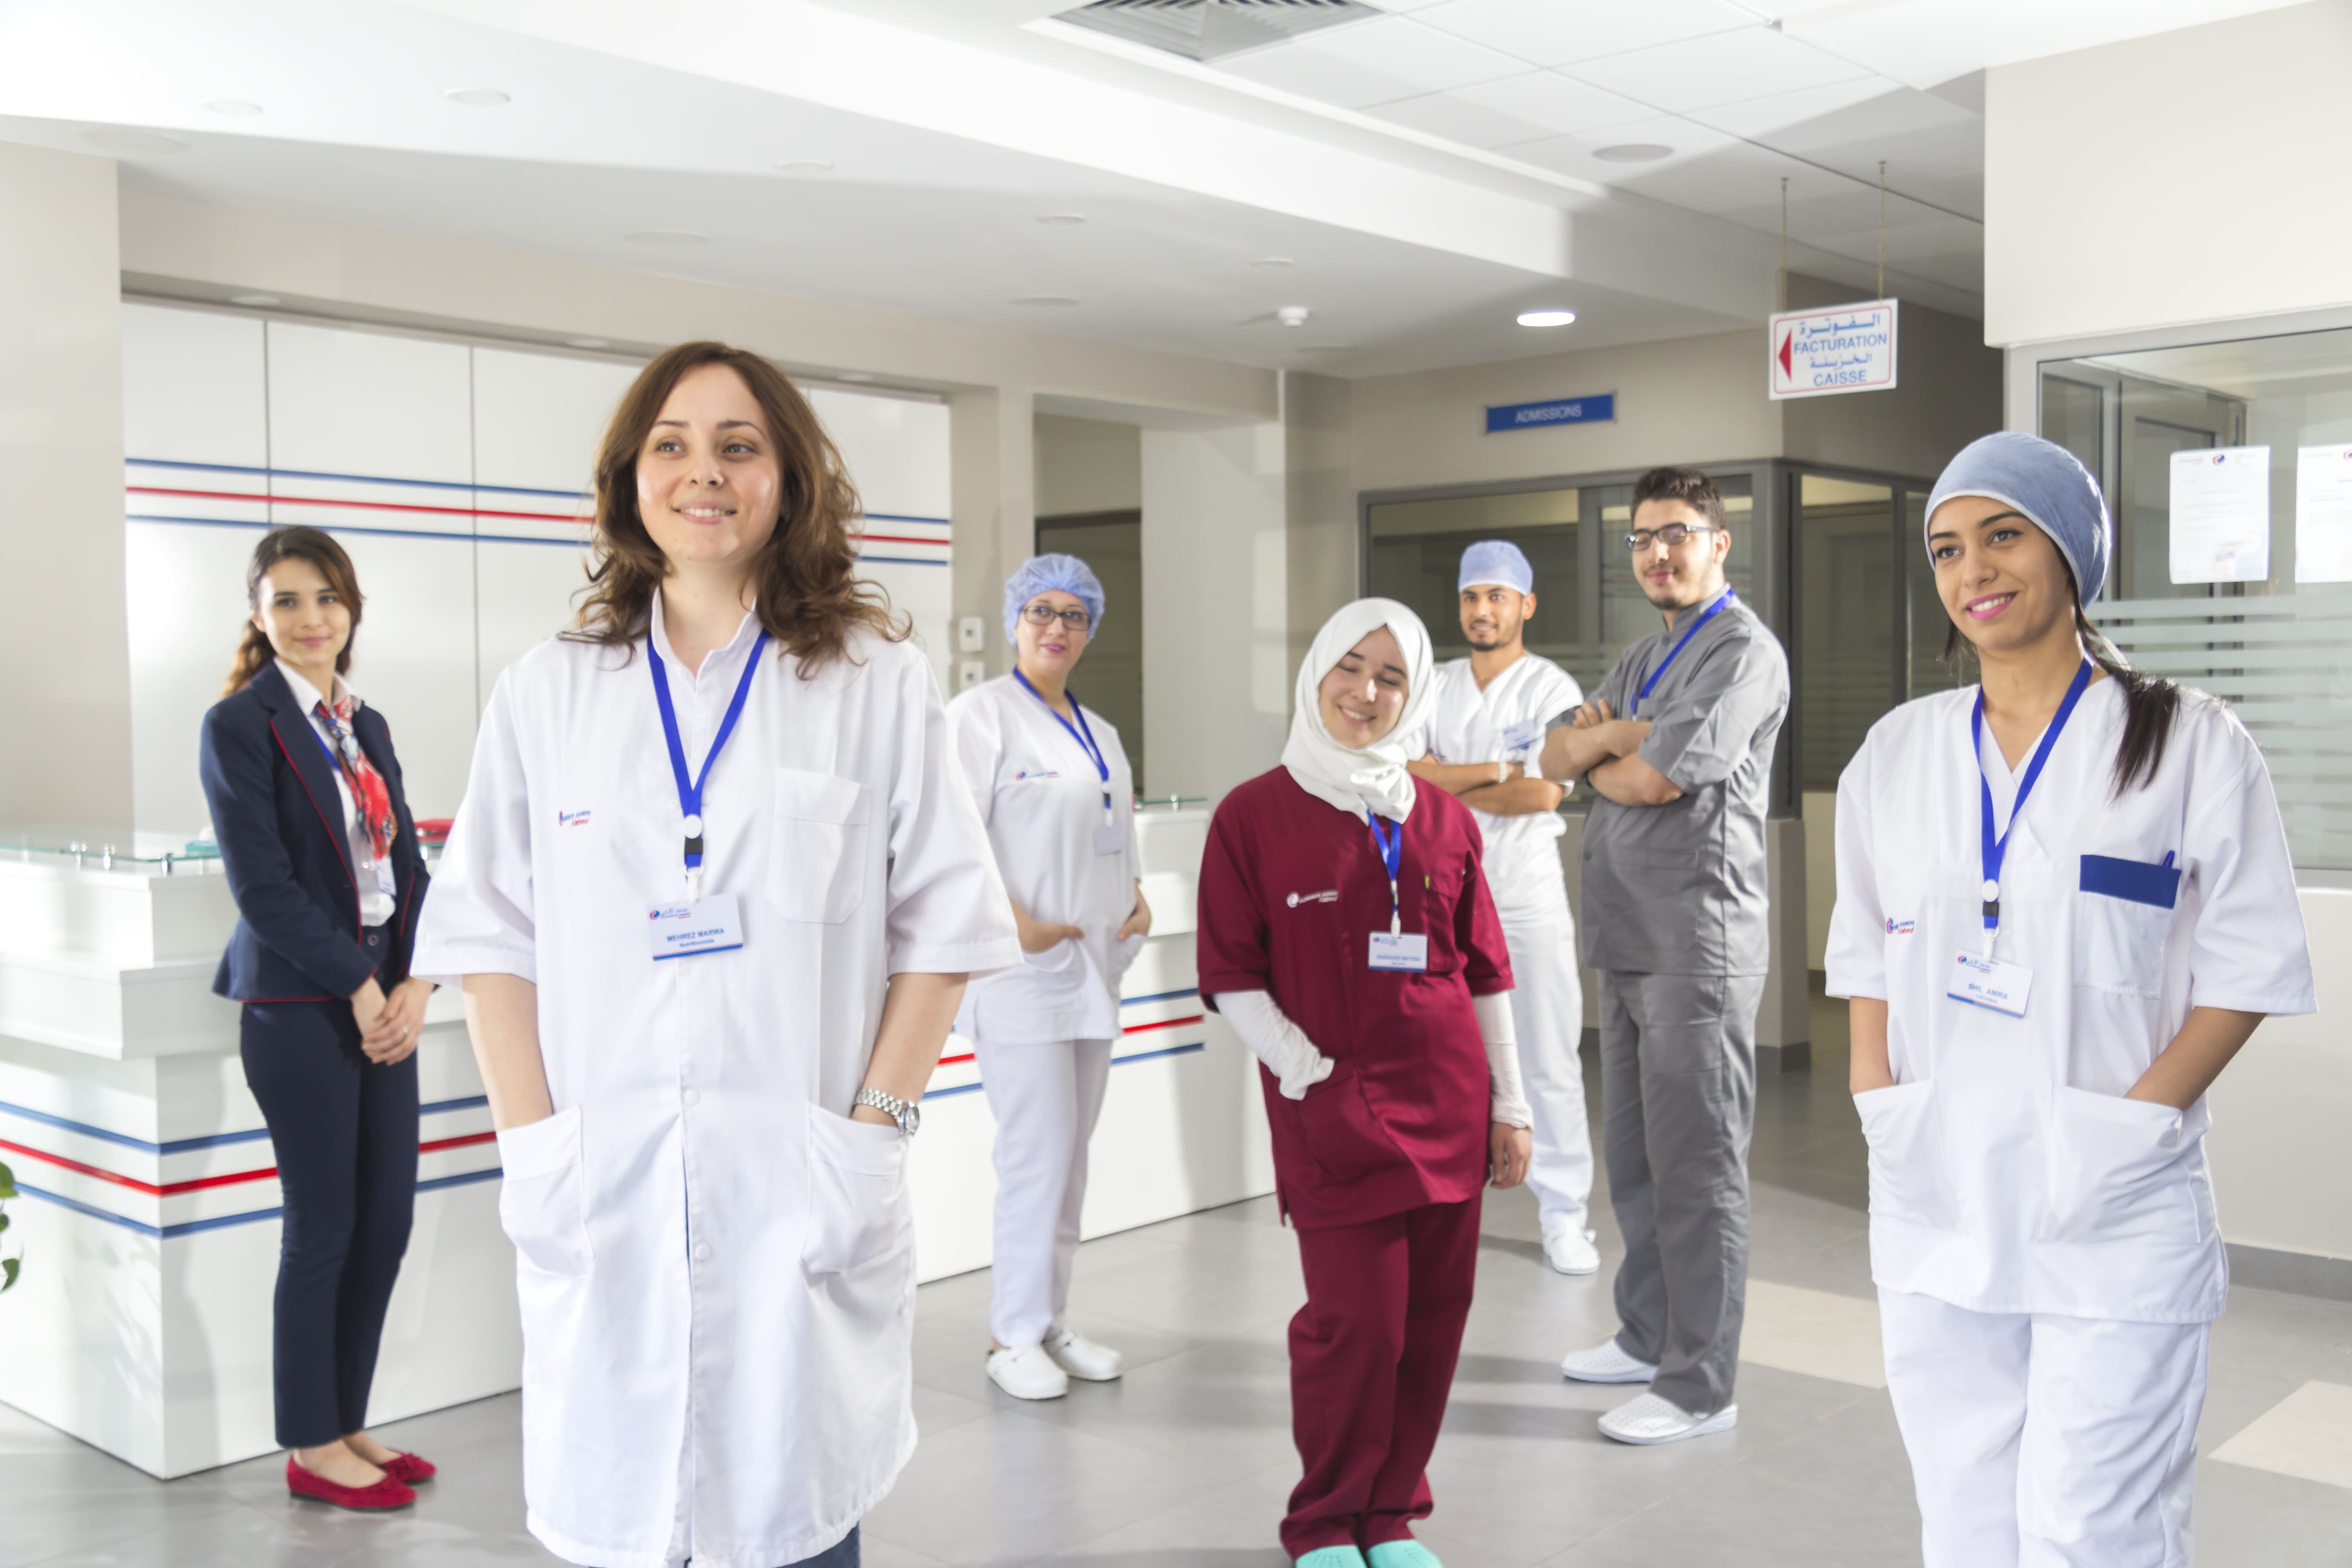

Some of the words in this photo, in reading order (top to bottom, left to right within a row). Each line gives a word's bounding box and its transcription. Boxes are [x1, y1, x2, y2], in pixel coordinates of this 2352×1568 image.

[1793, 333, 1887, 354] FACTURATION
[1813, 370, 1867, 386] CAISSE
[1515, 403, 1582, 424] ADMISSIONS
[666, 932, 696, 942] MEHREZ
[698, 928, 725, 937] MARWA
[1986, 989, 2008, 1000] AMIRA
